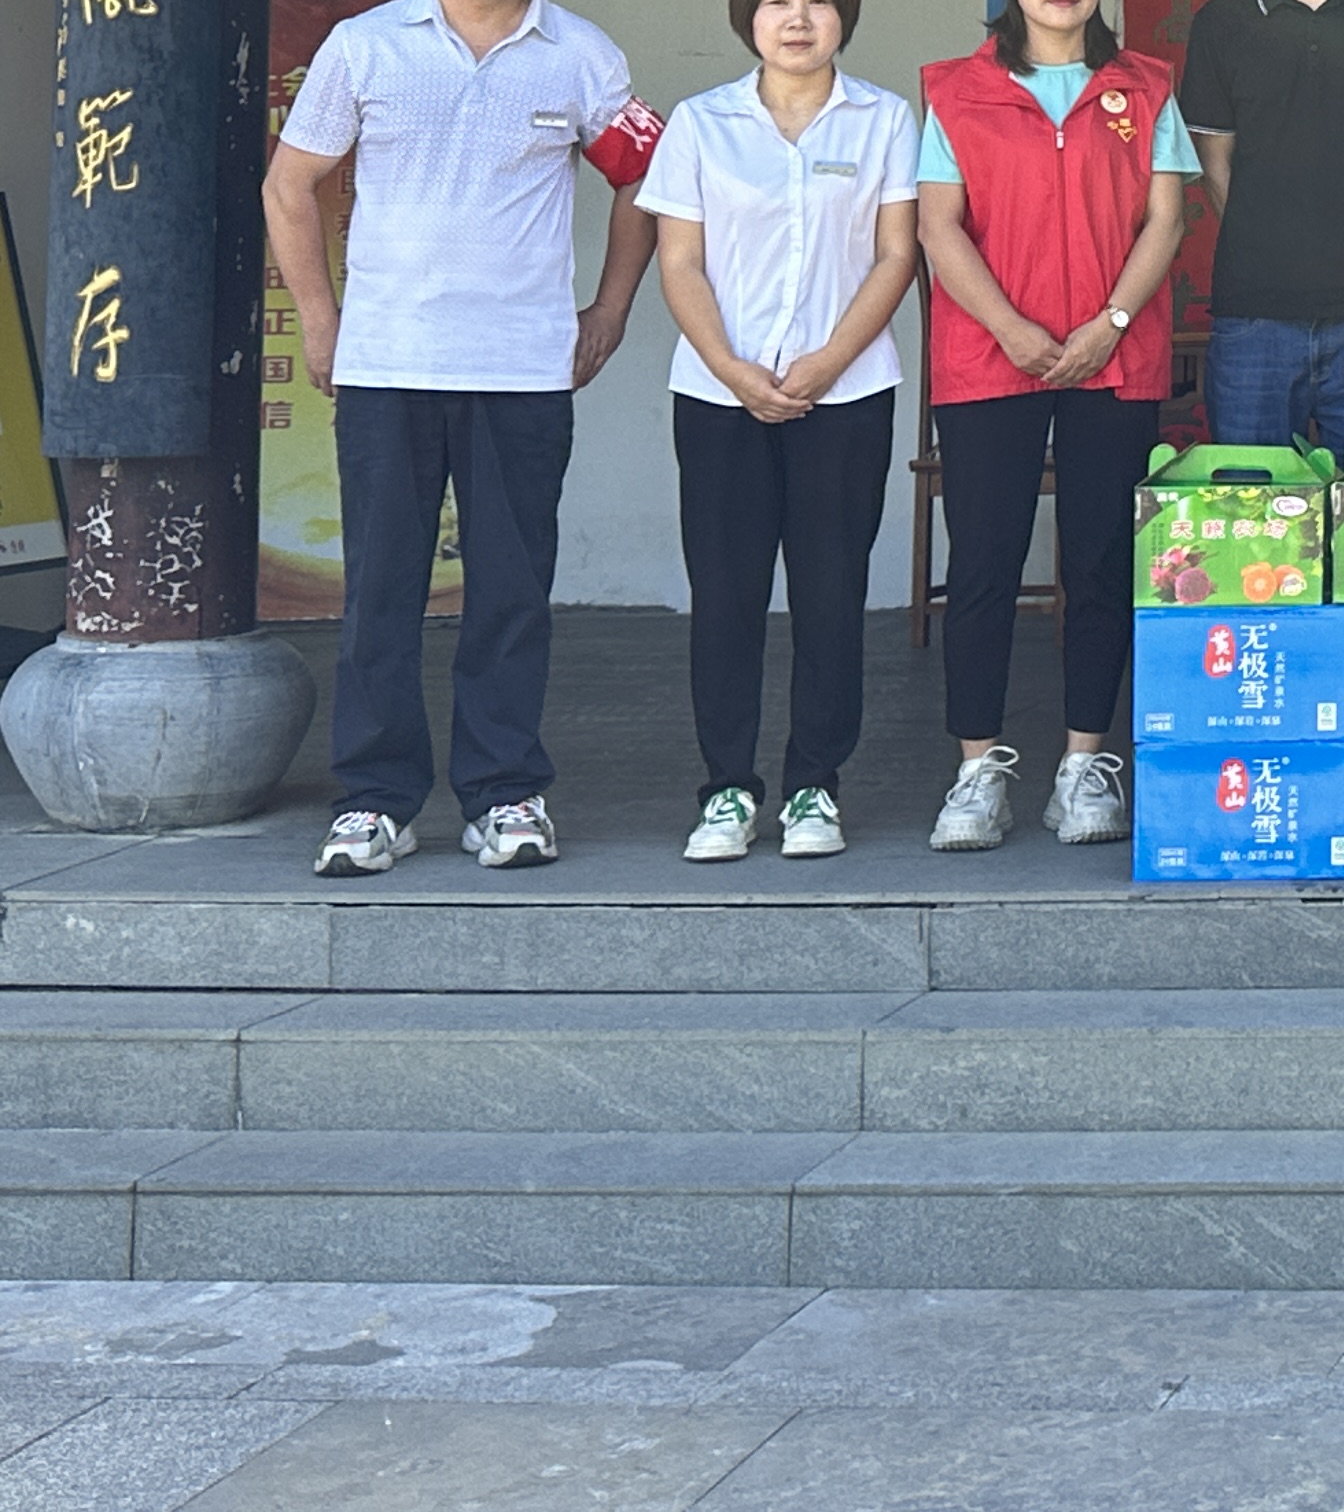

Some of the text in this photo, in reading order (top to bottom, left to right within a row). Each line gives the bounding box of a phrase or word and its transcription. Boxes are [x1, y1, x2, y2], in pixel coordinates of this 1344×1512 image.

[1210, 629, 1233, 673] 黄山
[1238, 624, 1269, 709] 无极雪
[1222, 764, 1245, 808] 黄山
[1251, 758, 1282, 844] 无极雪
